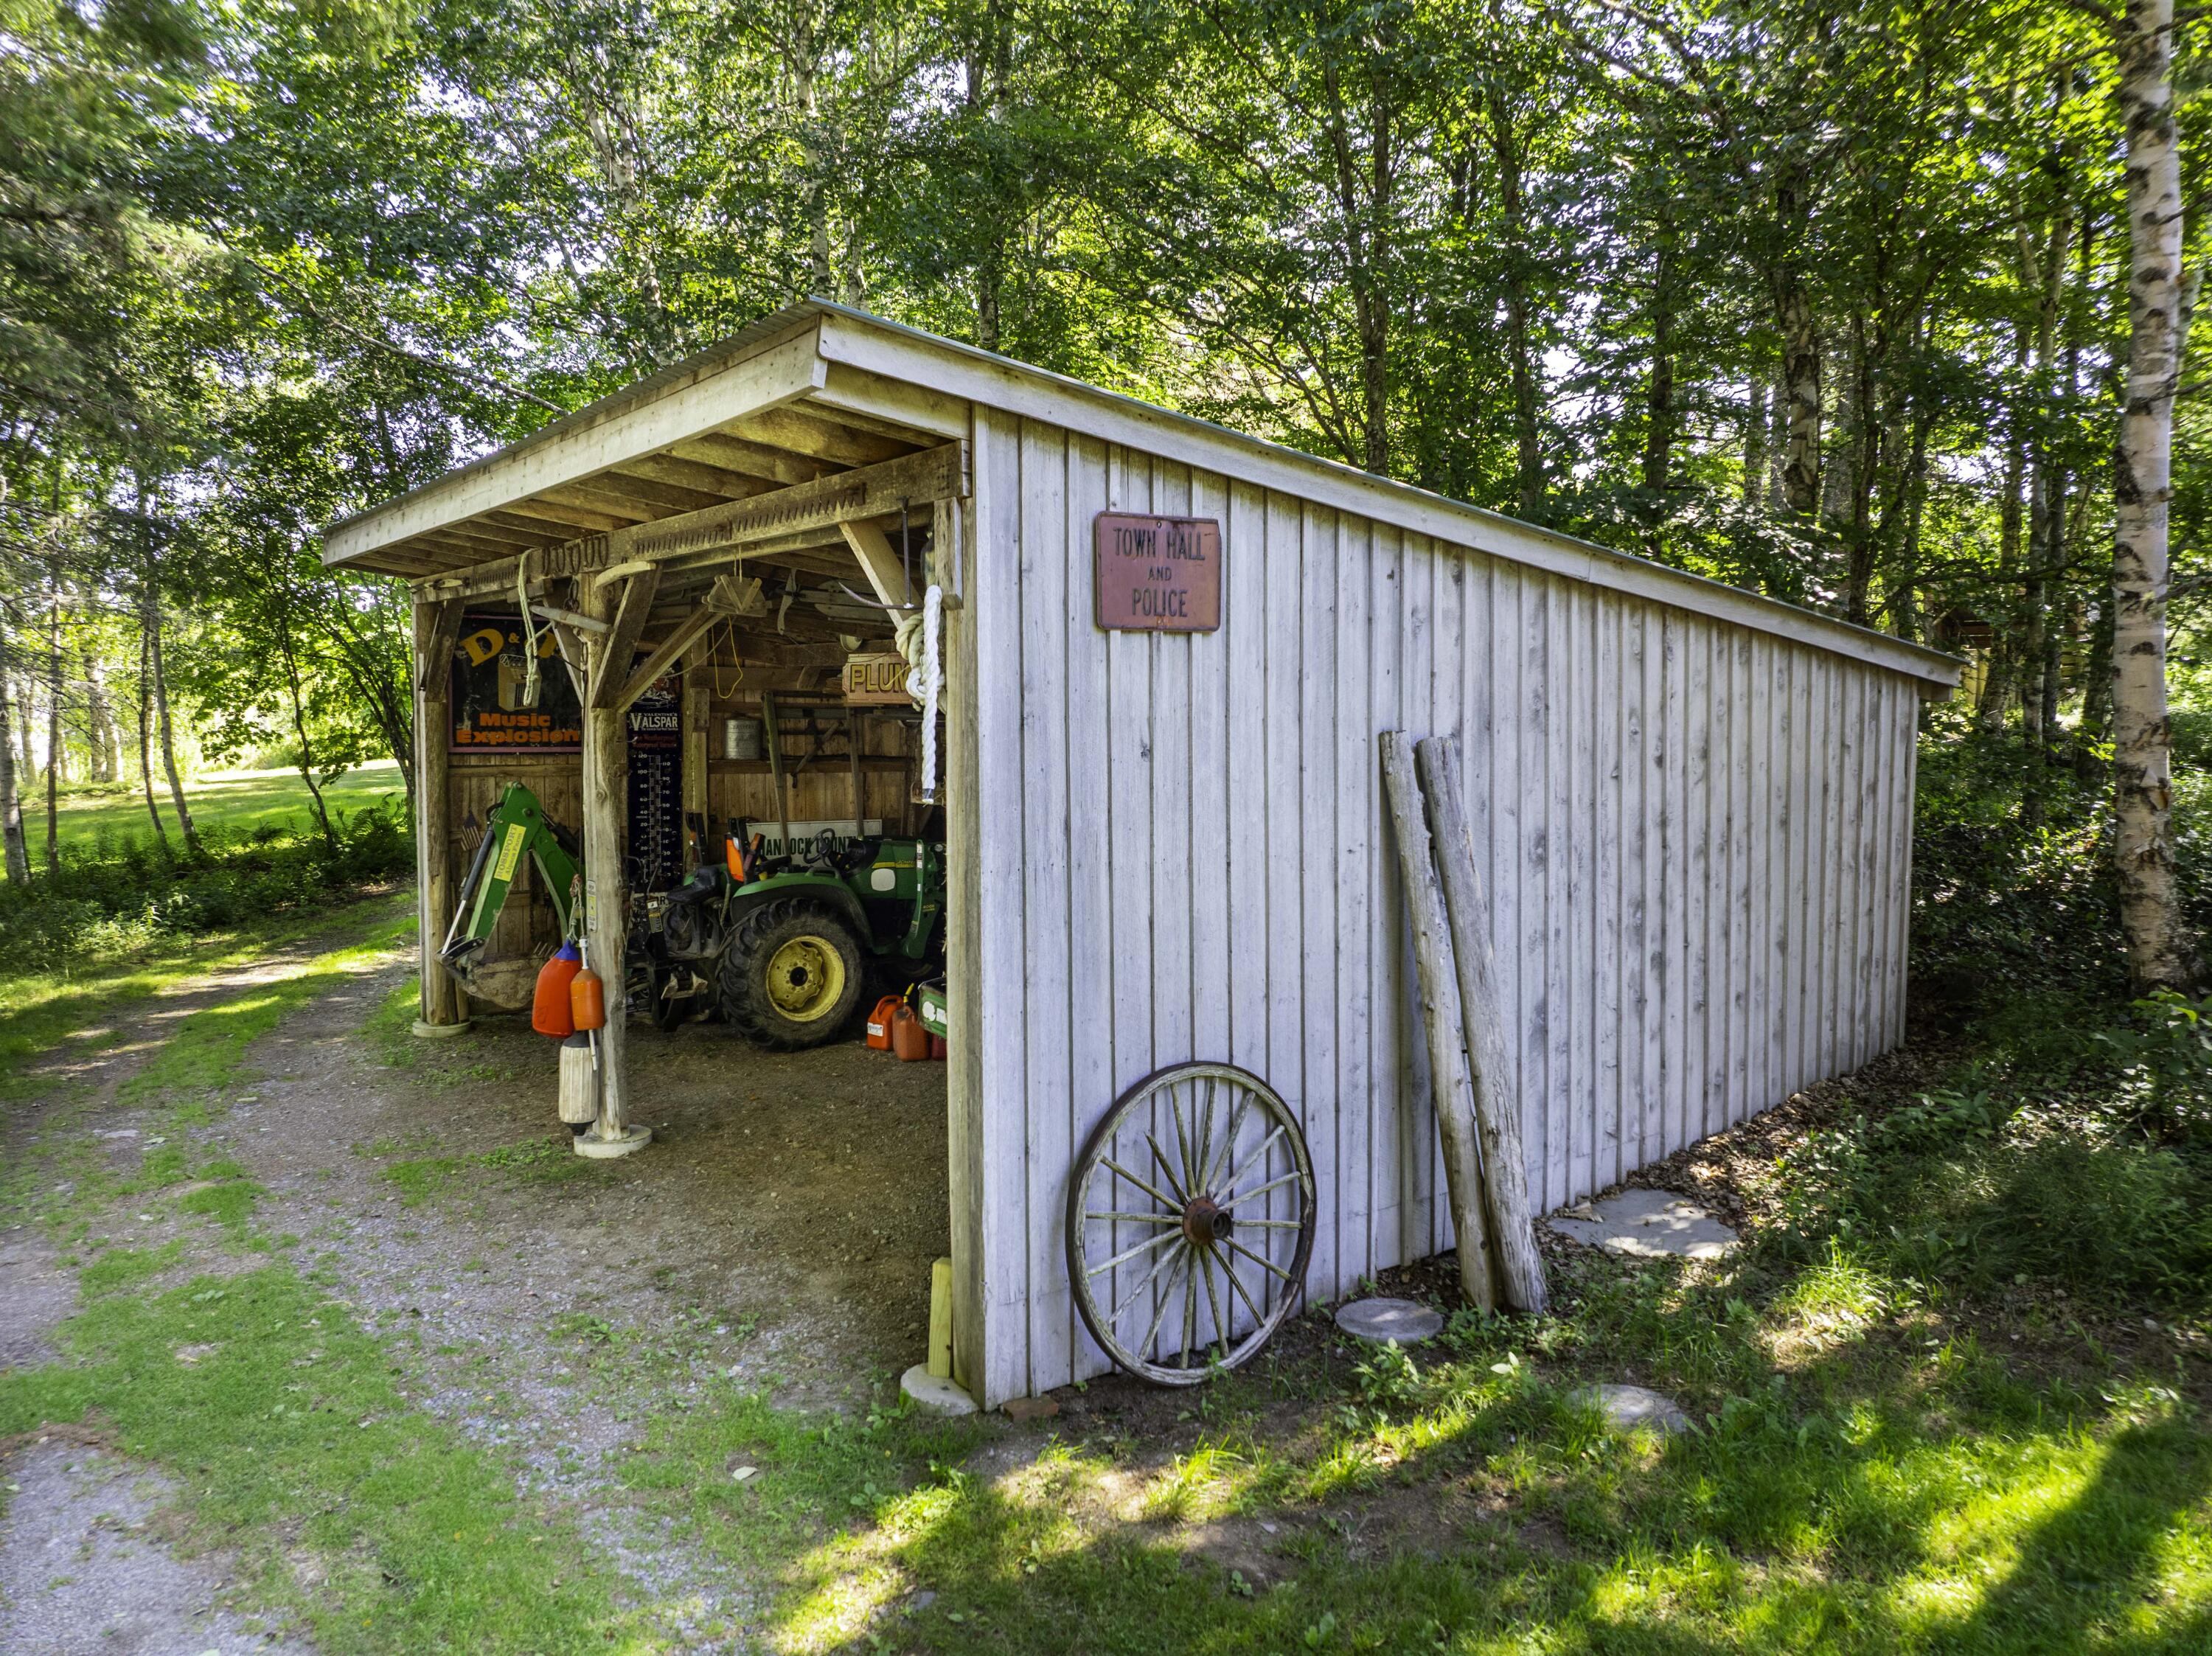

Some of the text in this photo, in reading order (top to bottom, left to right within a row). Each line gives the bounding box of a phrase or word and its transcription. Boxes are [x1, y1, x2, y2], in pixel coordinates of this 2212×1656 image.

[1113, 528, 1206, 561] TOWN HALL
[1147, 566, 1172, 581] AND
[1132, 588, 1188, 617] POLICE
[459, 628, 504, 667] D
[508, 633, 520, 644] &
[479, 713, 551, 727] Music
[630, 712, 678, 731] VALSPAR
[456, 728, 580, 745] Explosion
[497, 825, 517, 877] ROSSPORT
[760, 837, 812, 856] ANOCK
